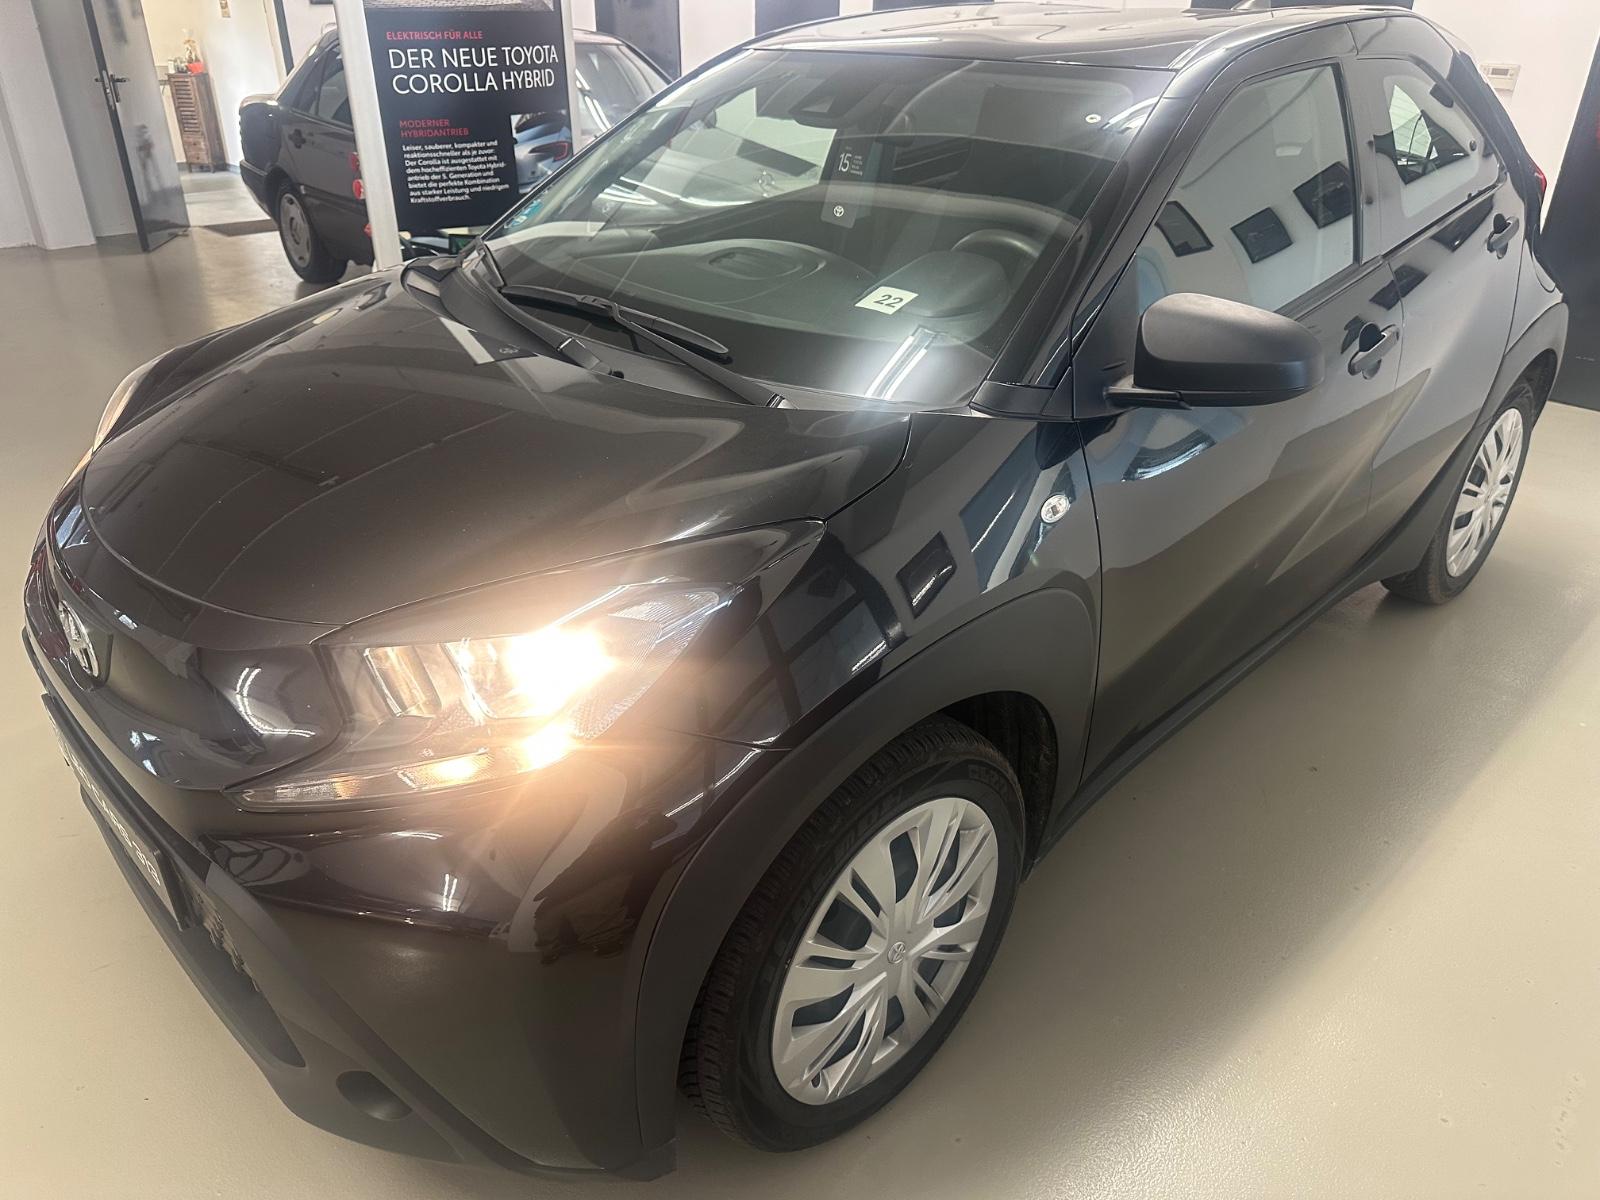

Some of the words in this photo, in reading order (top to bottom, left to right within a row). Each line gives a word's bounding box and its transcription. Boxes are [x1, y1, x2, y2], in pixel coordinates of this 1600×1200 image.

[387, 32, 441, 40] ELEKTRISCH
[445, 29, 461, 39] FÜR
[464, 31, 483, 39] ALLE
[389, 49, 435, 68] DER
[442, 47, 498, 67] NEUE
[502, 45, 558, 65] TOYOTA
[393, 72, 498, 94] COROLLA
[502, 69, 554, 90] HYBRID
[401, 128, 469, 137] HYBRIDANTRIEB
[404, 150, 460, 158] reaktionsschneller
[451, 156, 487, 165] ausgestattet
[838, 153, 851, 172] 15
[421, 165, 467, 173] hocheffizienten
[468, 164, 486, 172] Toyota
[438, 180, 463, 189] perfekte
[464, 177, 500, 186] Kombination
[444, 186, 469, 194] Leistung
[873, 294, 903, 308] 22
